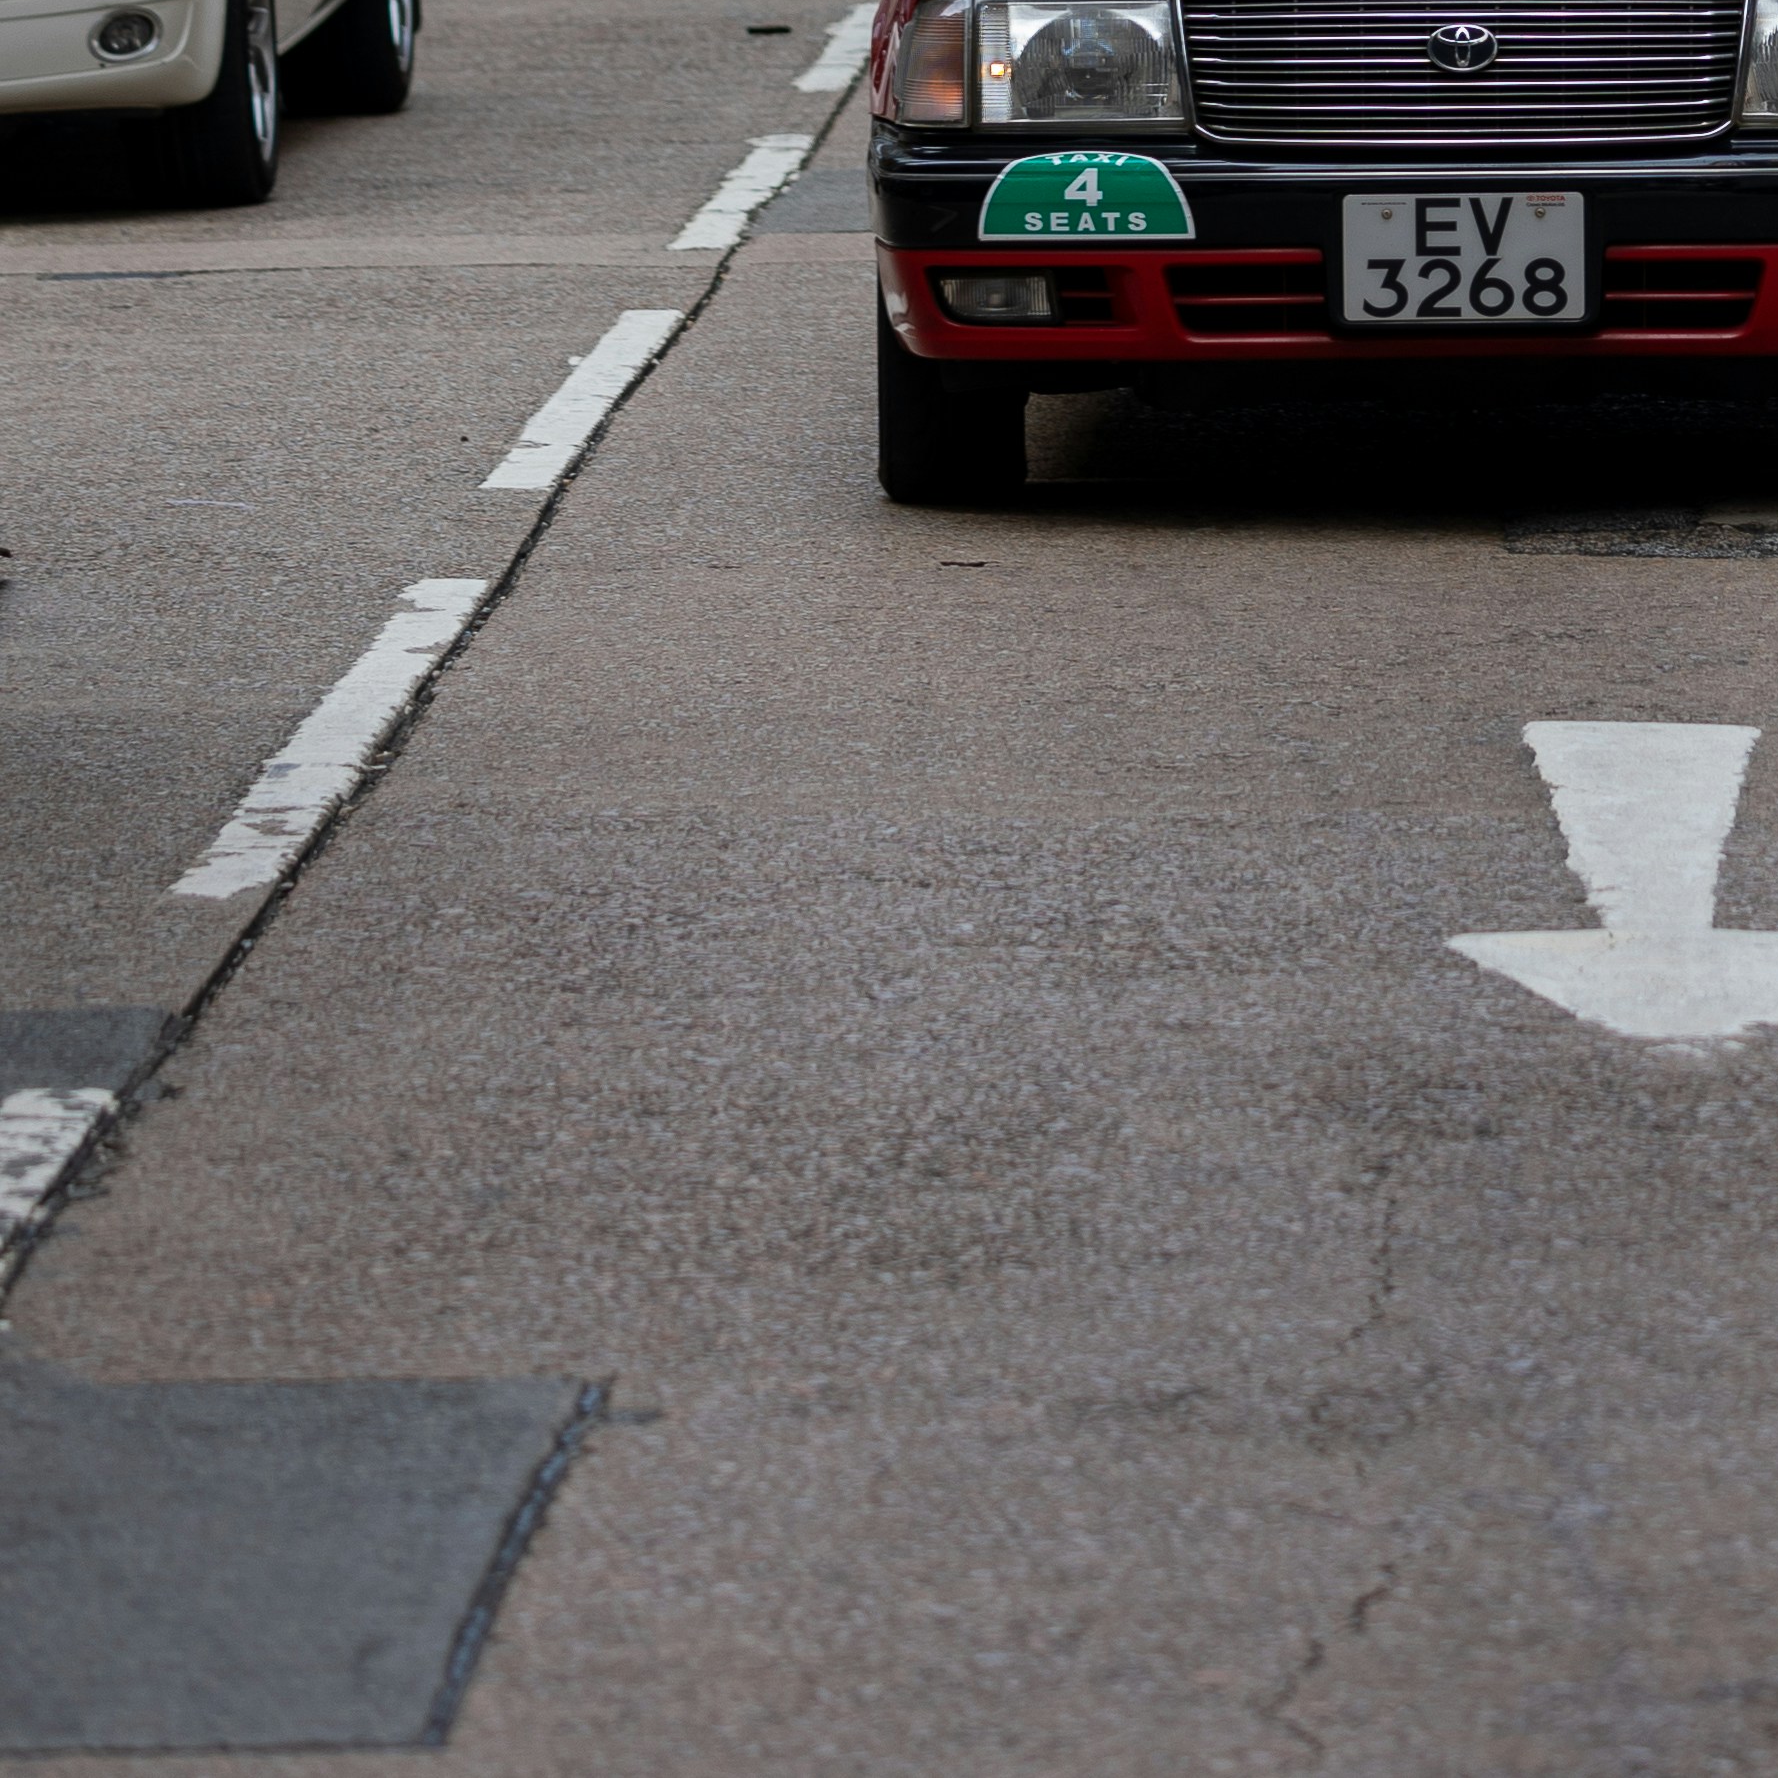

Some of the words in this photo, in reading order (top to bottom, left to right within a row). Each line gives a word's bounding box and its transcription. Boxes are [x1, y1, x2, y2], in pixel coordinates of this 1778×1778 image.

[1047, 151, 1128, 167] TAXI
[1064, 167, 1103, 207] 4
[1024, 212, 1147, 232] SEATS
[1414, 197, 1513, 257] EV
[1362, 257, 1568, 318] 3268
